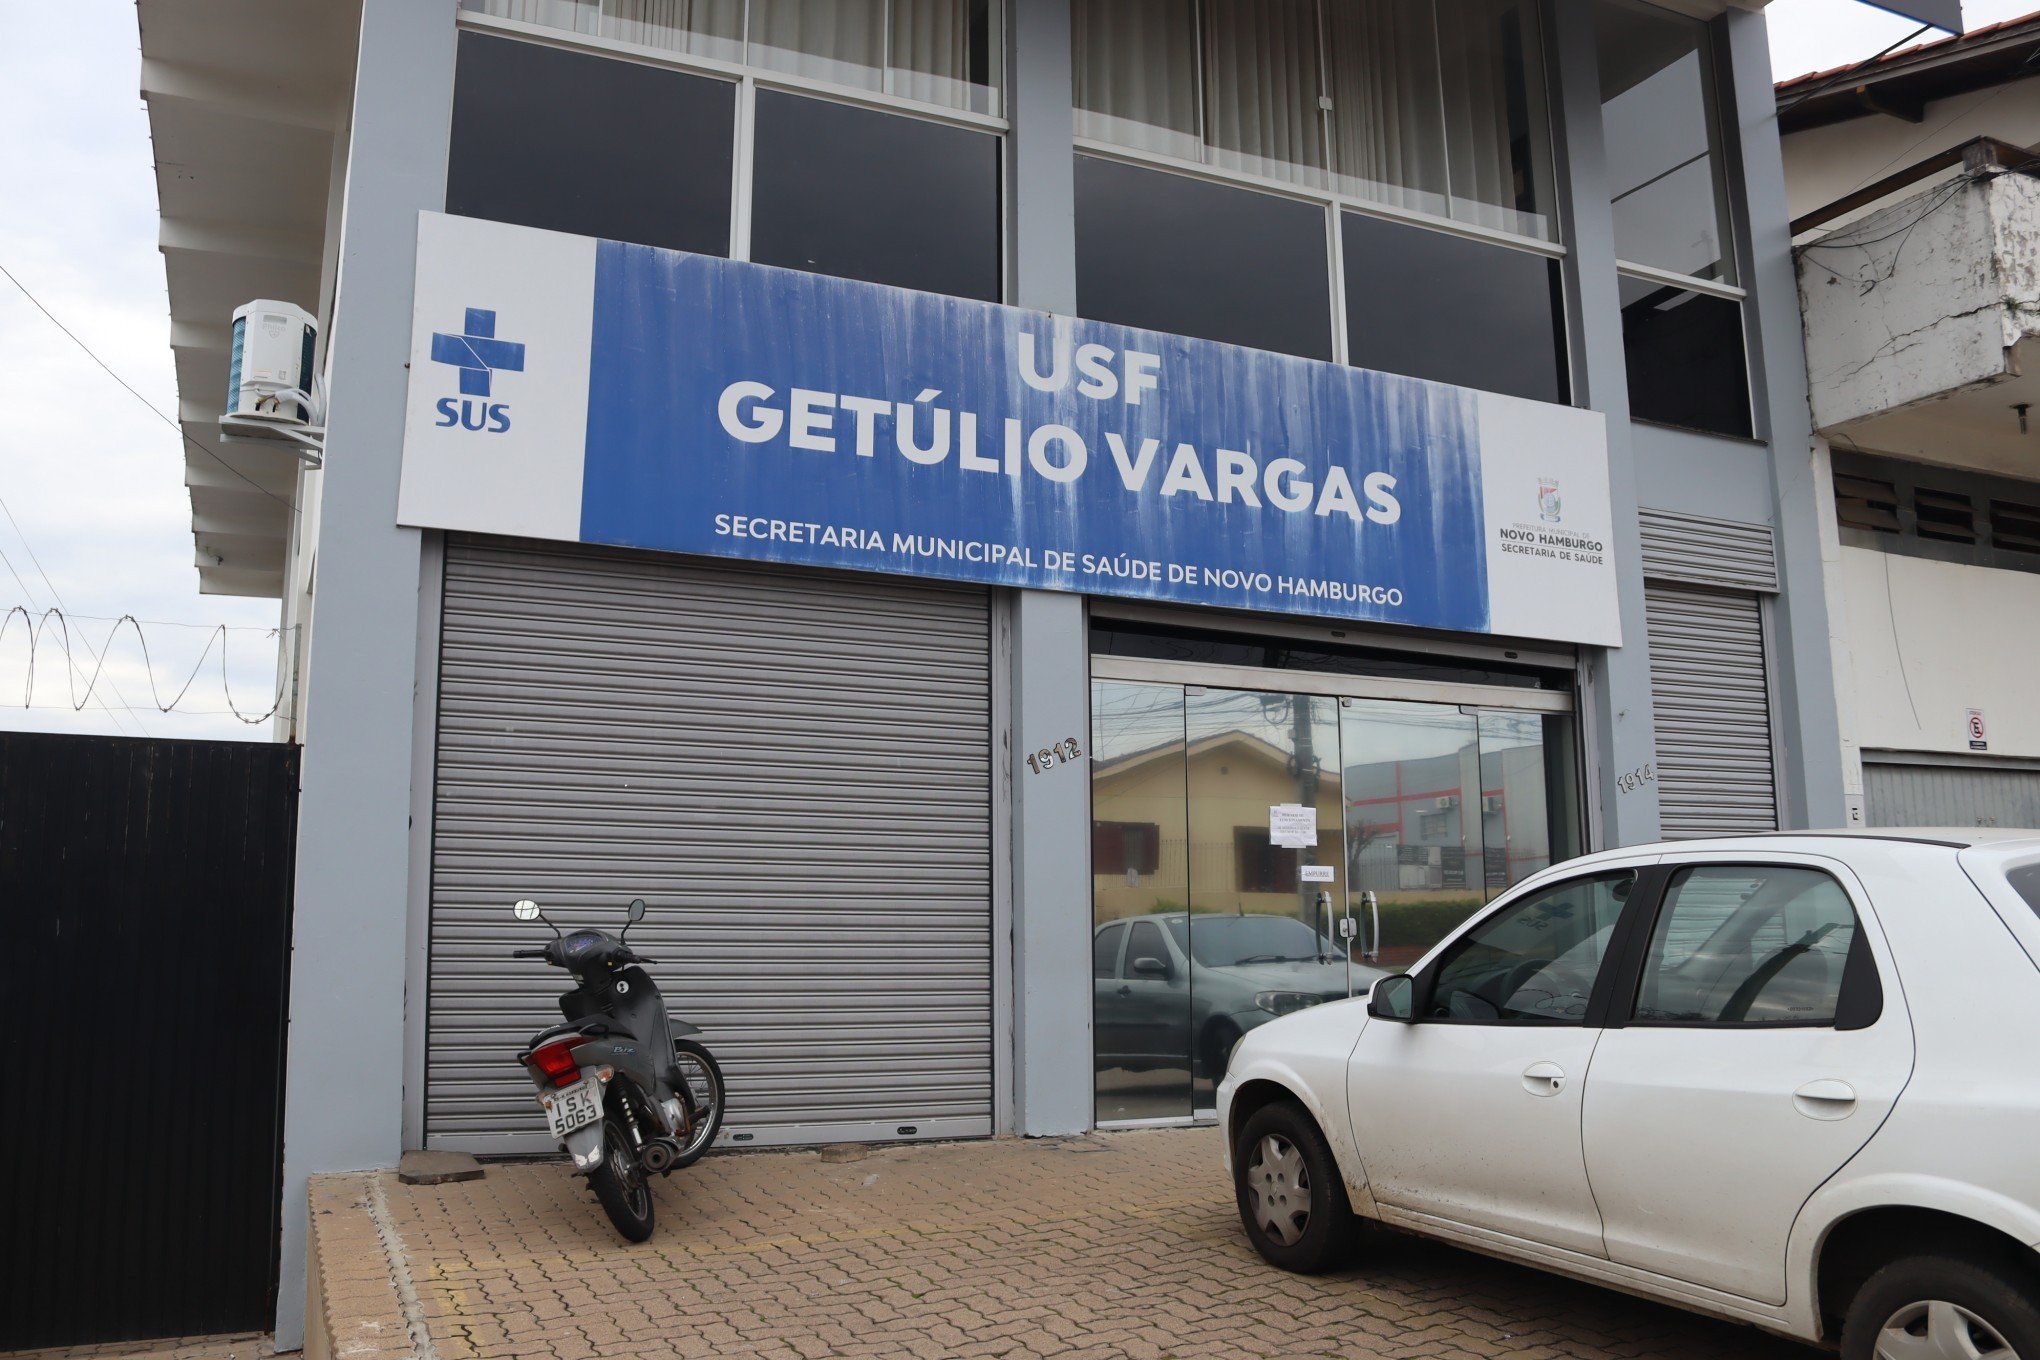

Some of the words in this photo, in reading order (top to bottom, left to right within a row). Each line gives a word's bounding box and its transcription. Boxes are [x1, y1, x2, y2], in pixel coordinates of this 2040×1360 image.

[1018, 332, 1161, 405] USF
[435, 397, 511, 433] SUS
[717, 380, 1088, 483] GETÚLIO
[1105, 432, 1402, 525] VARGAS
[1500, 528, 1535, 542] NOVO
[1539, 534, 1603, 552] HAMBURGO
[1501, 543, 1556, 558] SECRETARIA
[1560, 551, 1571, 561] DE
[1574, 552, 1604, 565] SAÚDE
[714, 514, 885, 551] SECRETARIA
[893, 533, 1037, 568] MUNICIPAL
[1044, 550, 1076, 571] DE
[1082, 553, 1162, 581] SAÚDE
[1169, 563, 1198, 585] DE
[1204, 568, 1272, 593] NOVO
[1278, 576, 1403, 606] HAMBURGO
[1027, 737, 1082, 774] 1912
[1617, 763, 1655, 794] 1914
[555, 1105, 597, 1134] 5063
[556, 1090, 592, 1117] ISK
